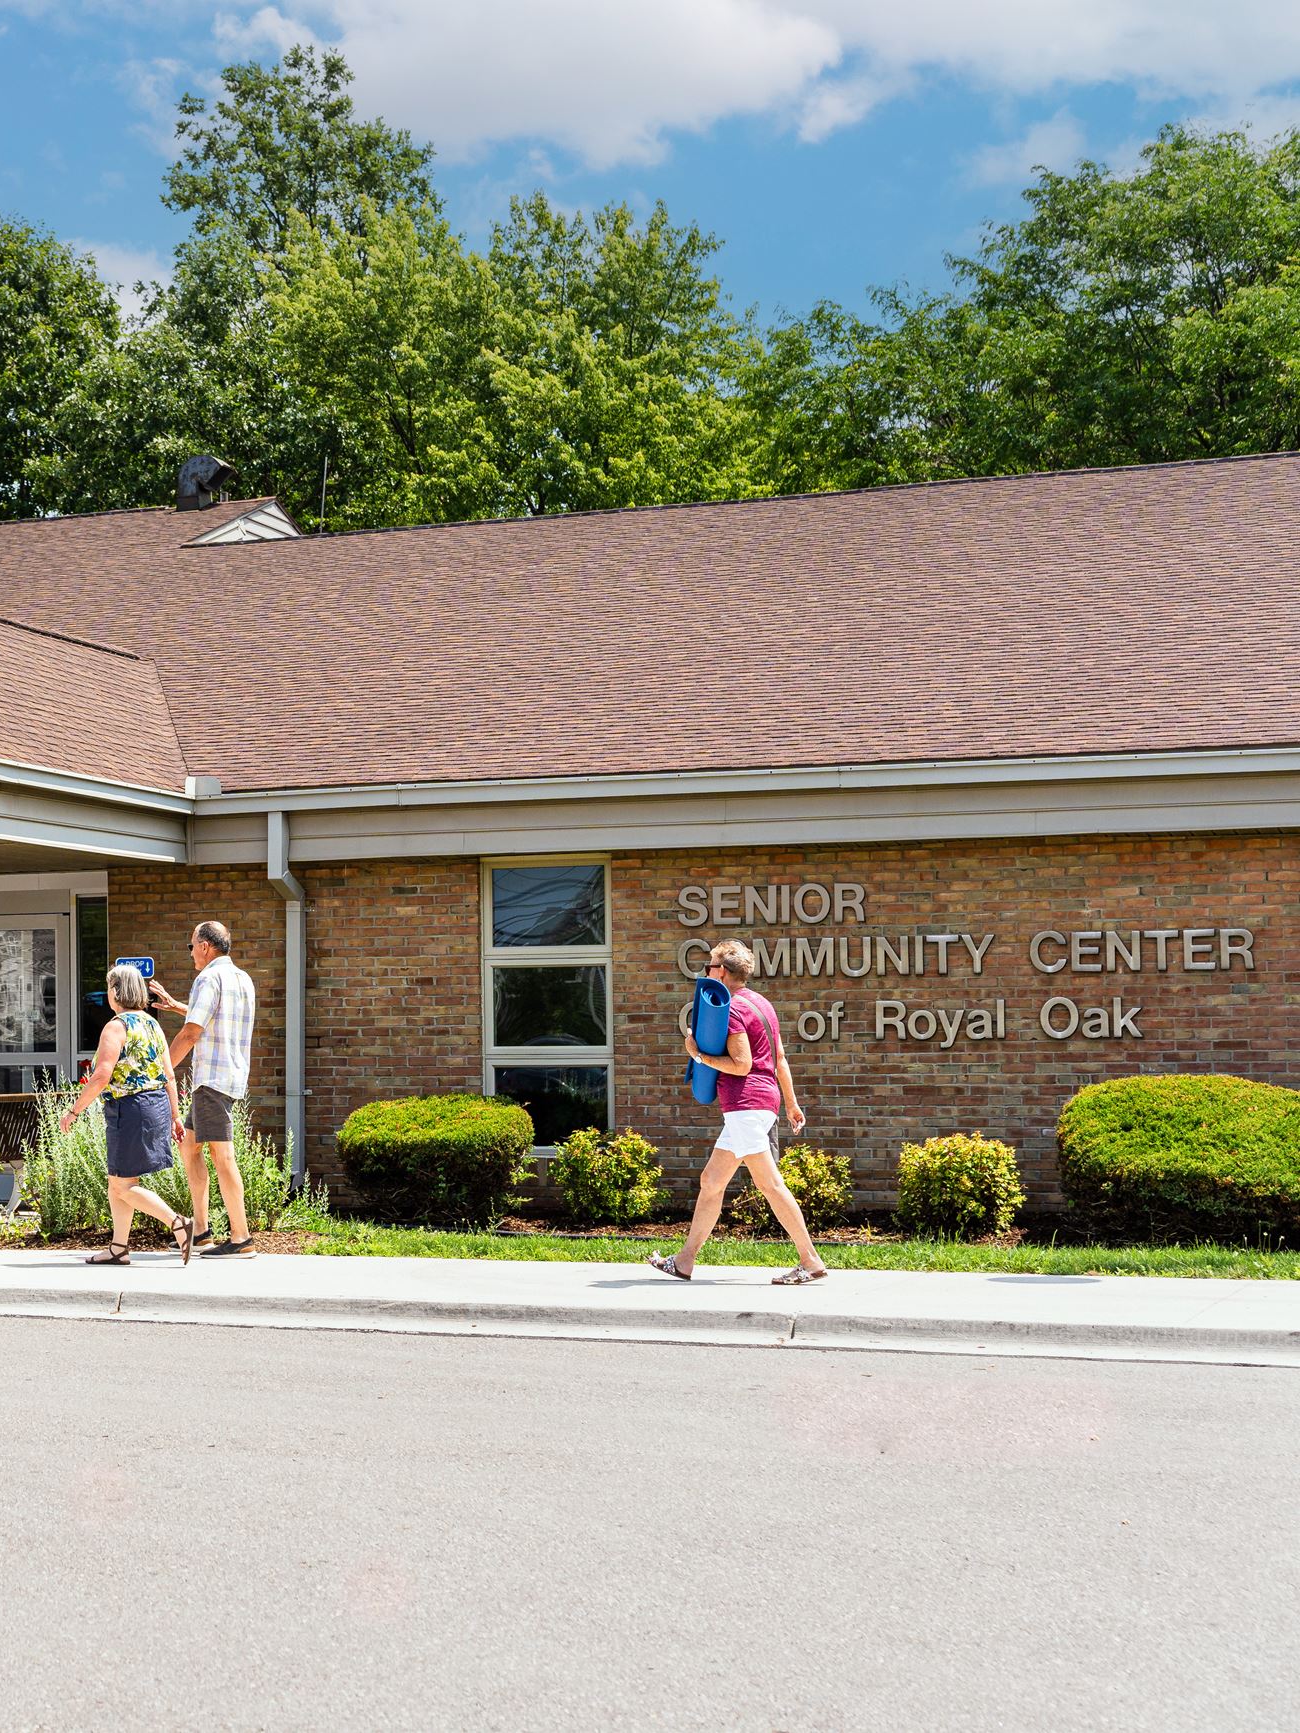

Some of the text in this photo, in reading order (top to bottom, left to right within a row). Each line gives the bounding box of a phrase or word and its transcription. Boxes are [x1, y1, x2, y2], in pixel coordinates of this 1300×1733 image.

[677, 883, 866, 926] SENIOR
[677, 928, 1255, 980] CMMUNITY CENTER
[797, 996, 1143, 1048] of Royal Oak
